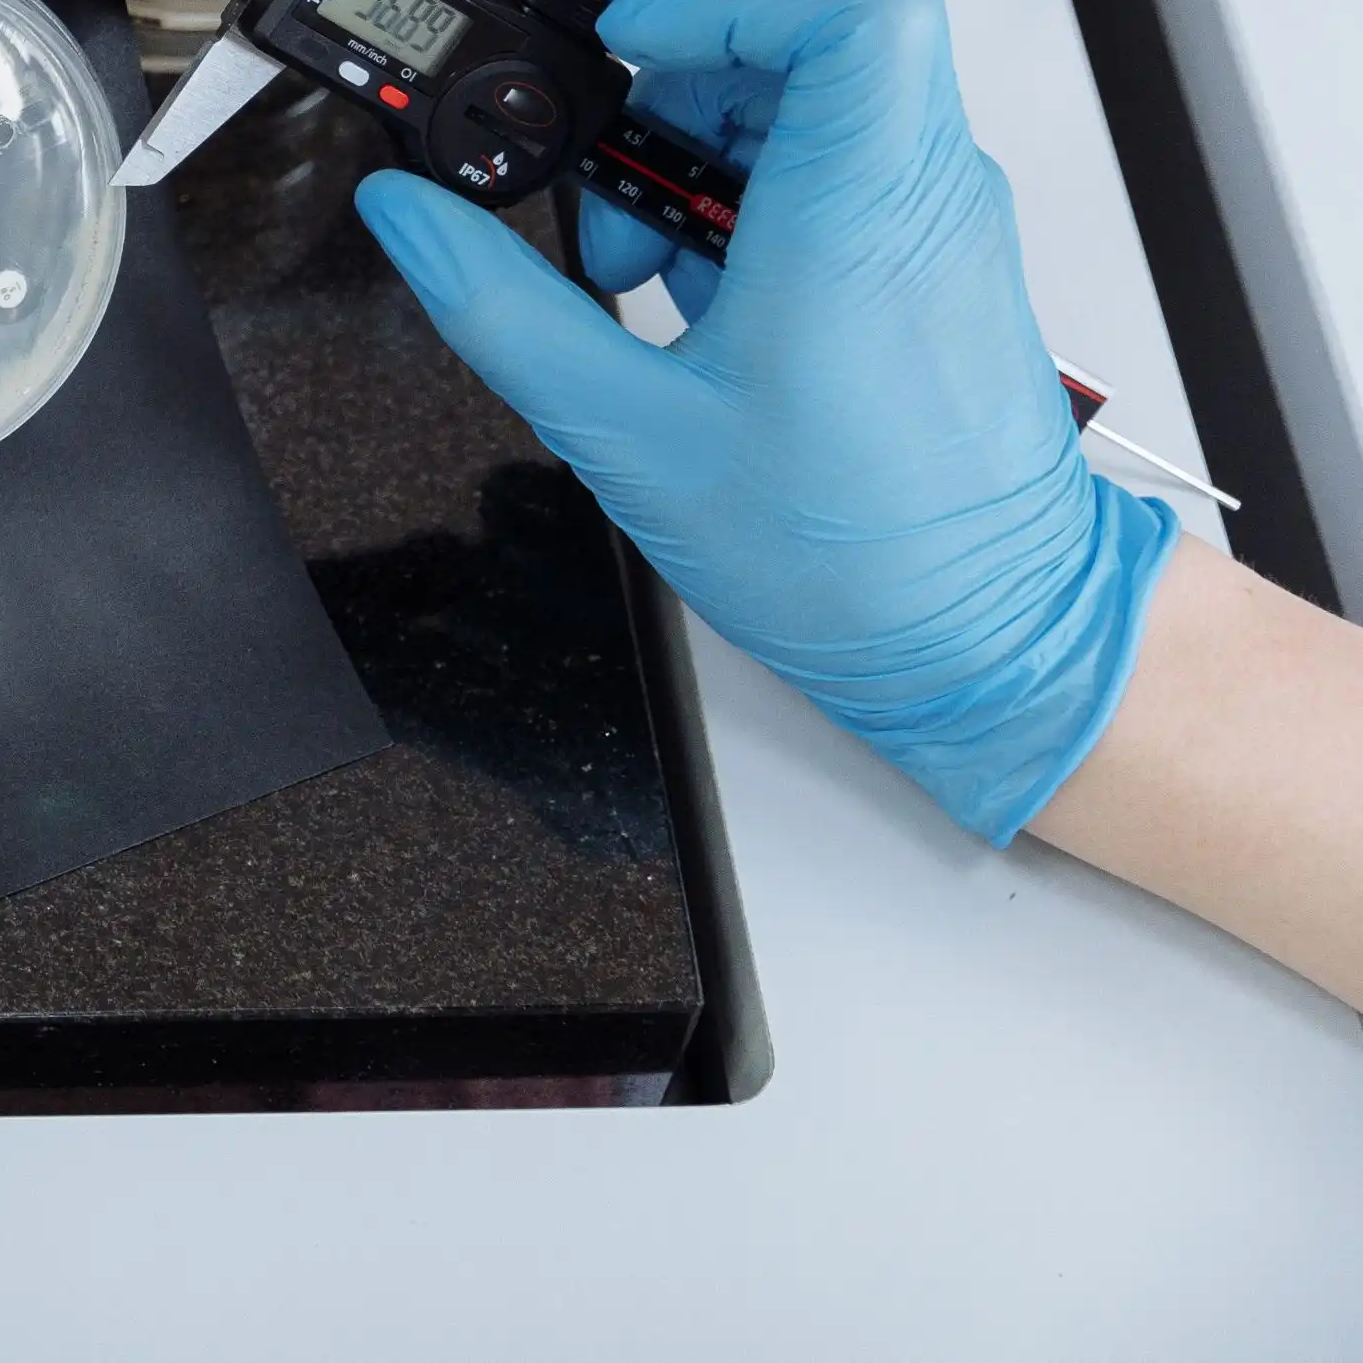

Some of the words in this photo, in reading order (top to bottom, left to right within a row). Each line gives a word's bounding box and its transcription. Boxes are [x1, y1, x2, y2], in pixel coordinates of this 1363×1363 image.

[348, 38, 388, 66] mm/inch
[623, 129, 641, 145] 4.5
[459, 162, 490, 185] IP67
[688, 166, 698, 178] 5
[617, 179, 638, 197] 120
[662, 205, 683, 222] 130
[706, 230, 726, 248] 140
